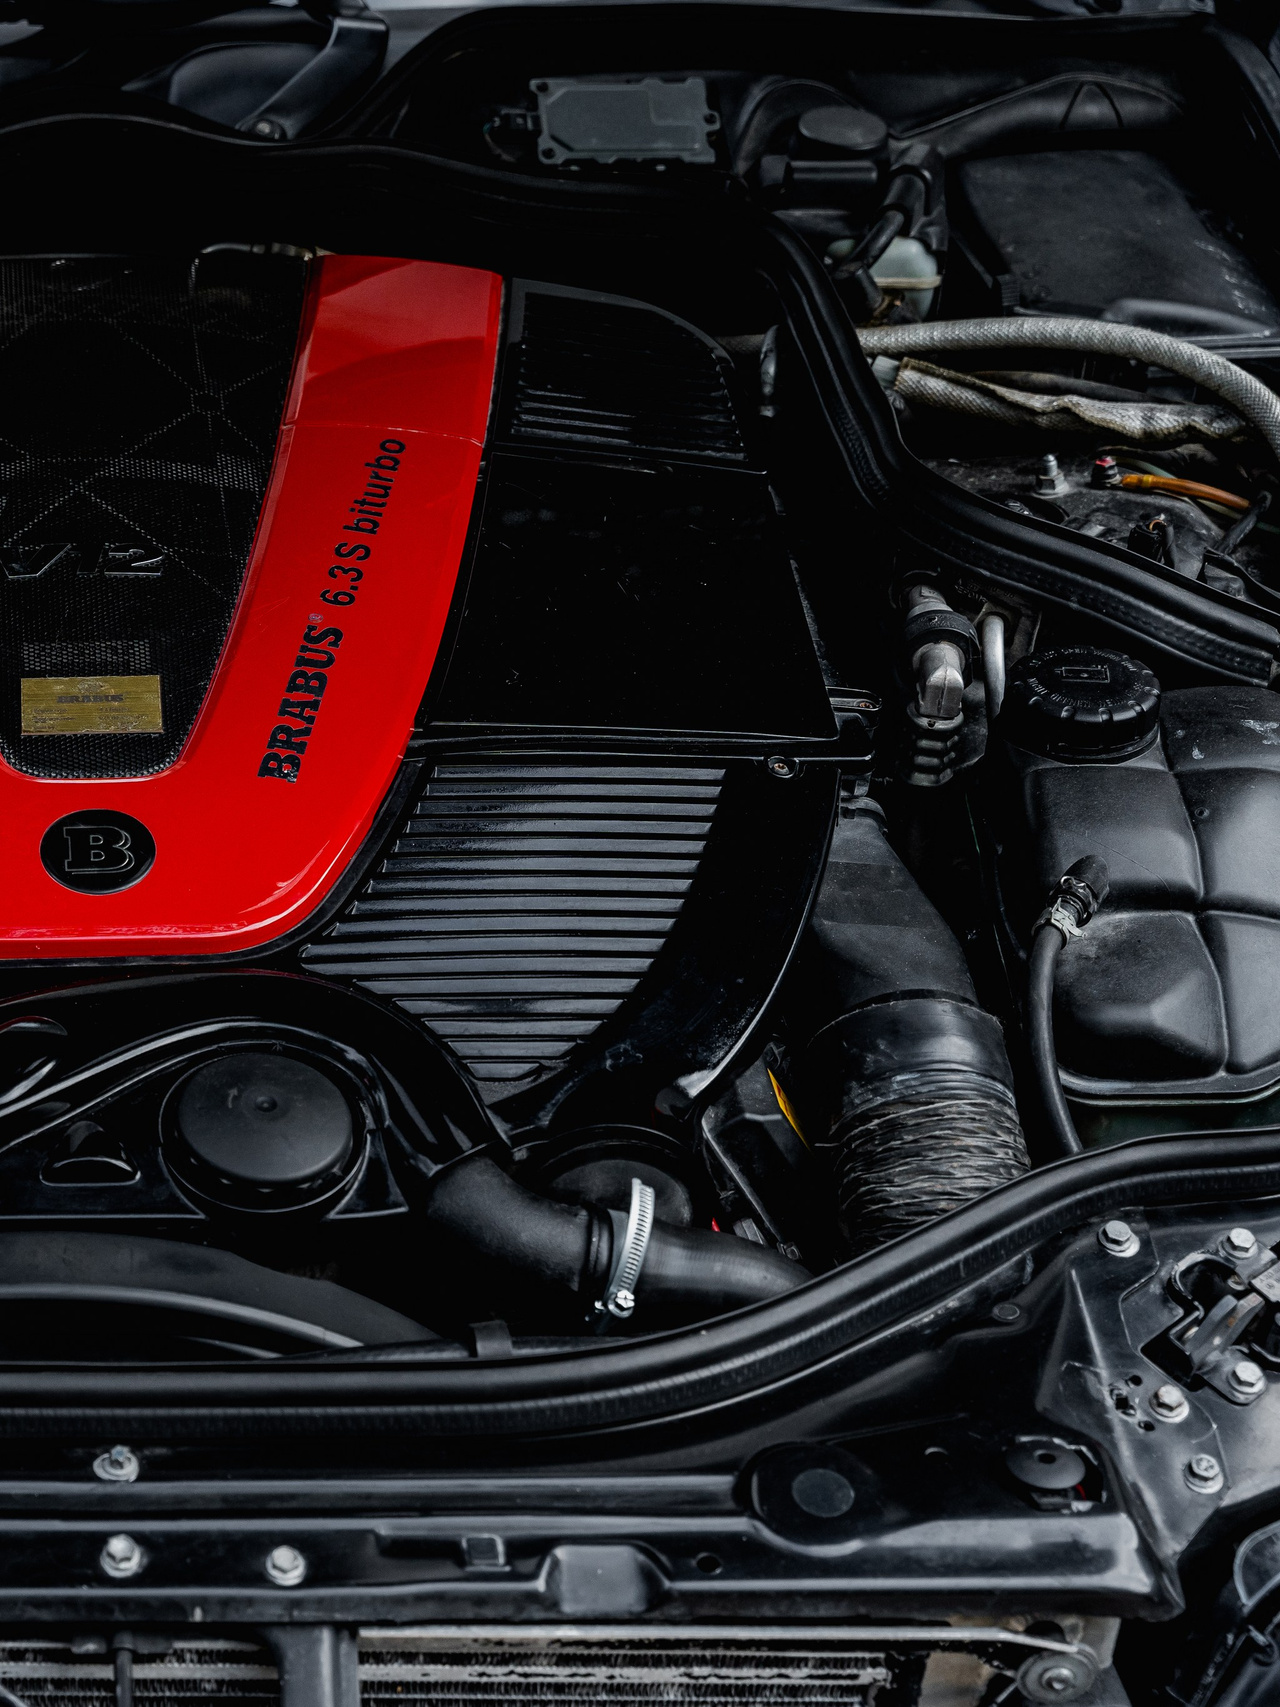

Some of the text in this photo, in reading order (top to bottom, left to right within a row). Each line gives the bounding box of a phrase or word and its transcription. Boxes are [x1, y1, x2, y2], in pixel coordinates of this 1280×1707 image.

[342, 438, 406, 535] biturbo
[334, 541, 371, 561] S
[320, 564, 364, 607] 6.3
[63, 826, 135, 875] B
